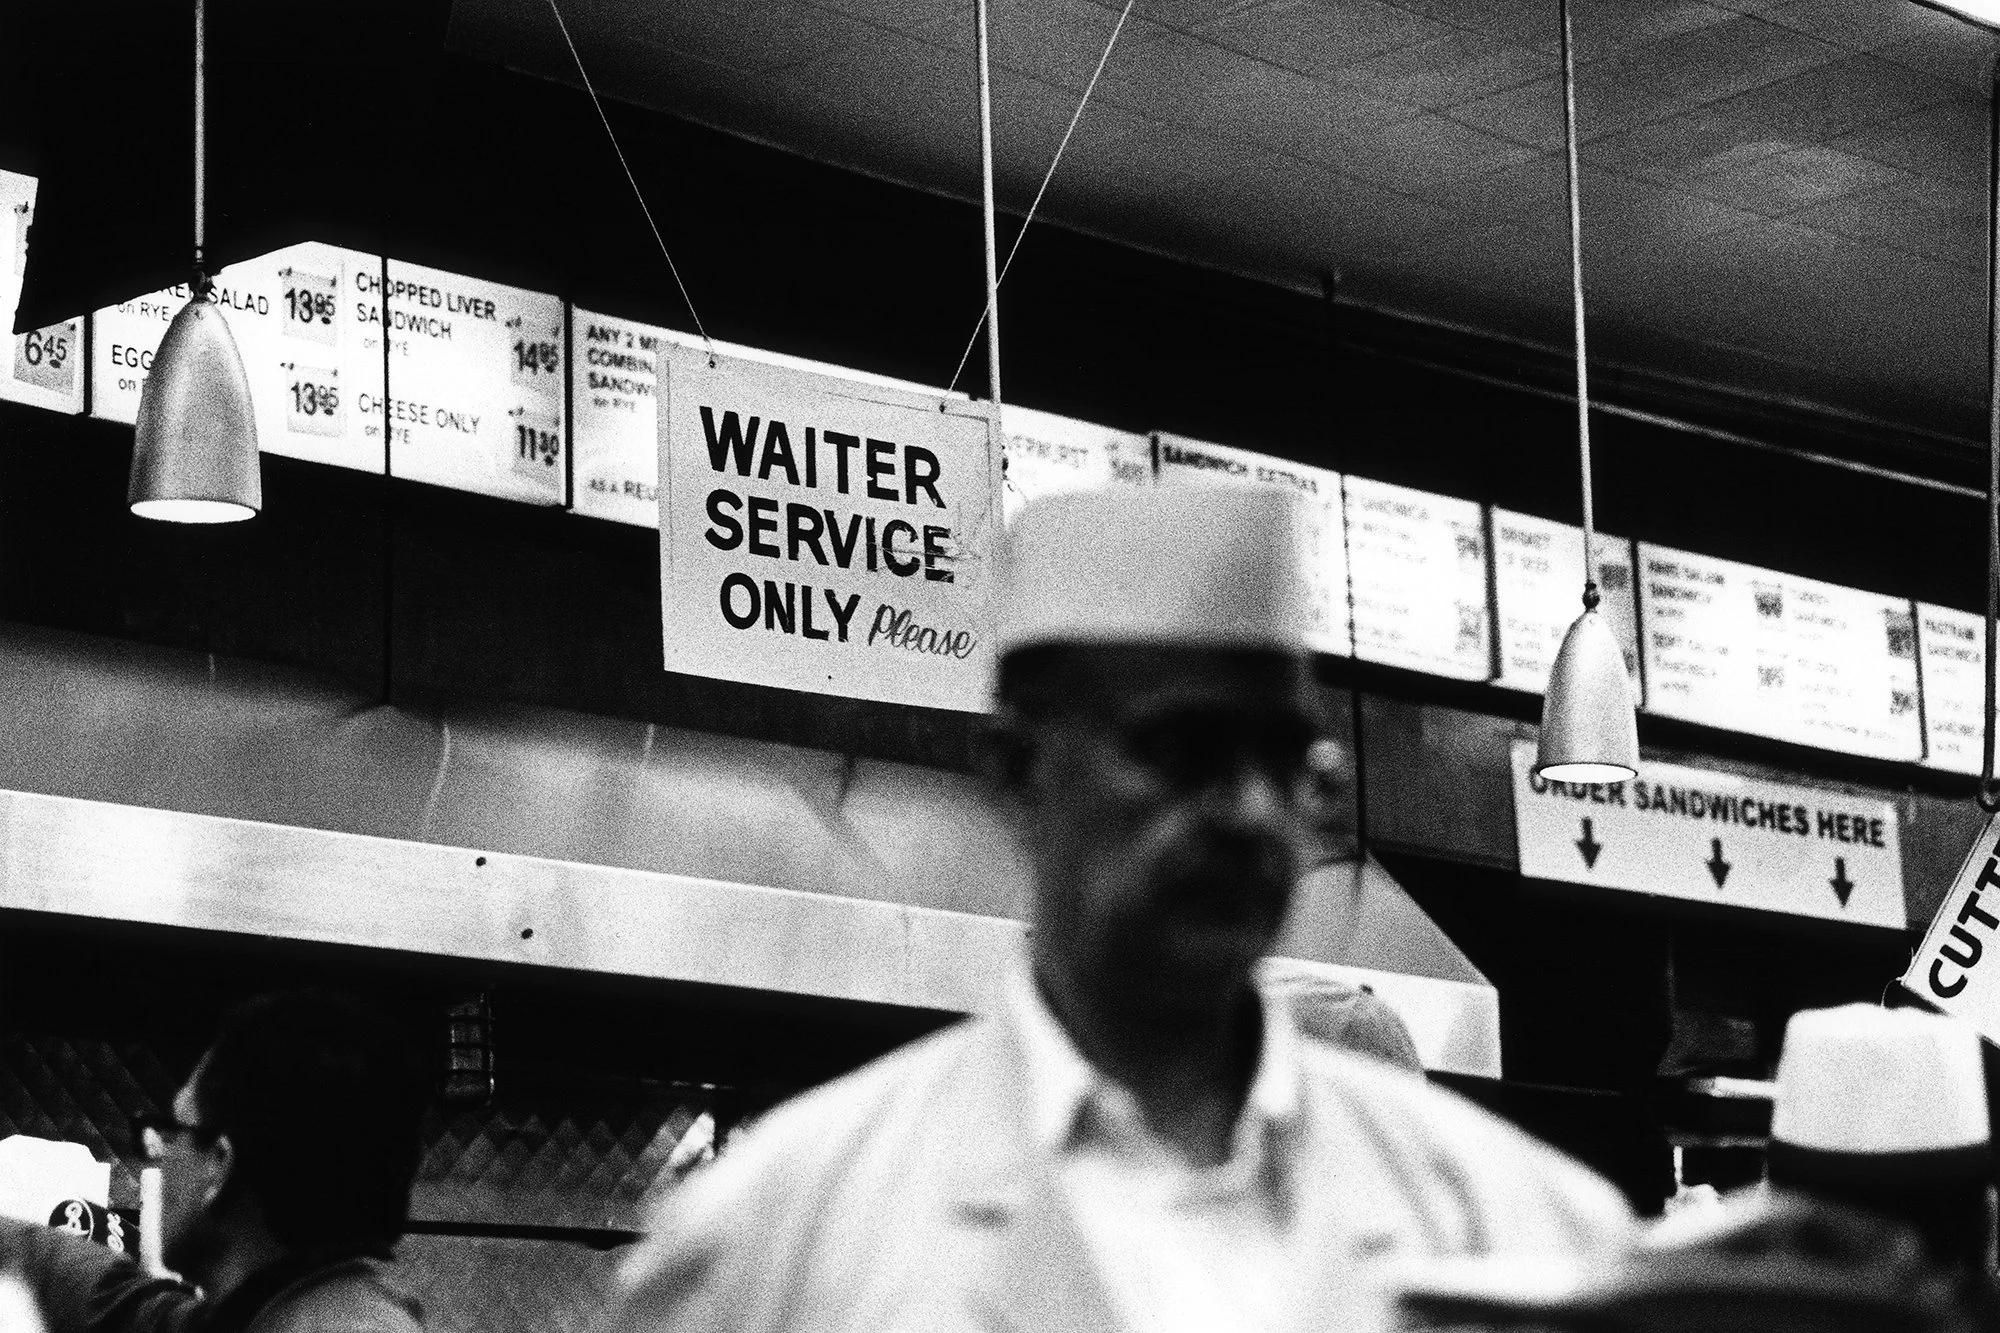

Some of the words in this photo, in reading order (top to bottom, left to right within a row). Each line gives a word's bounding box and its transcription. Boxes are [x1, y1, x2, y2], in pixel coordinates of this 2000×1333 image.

[140, 302, 170, 322] RYE
[206, 286, 269, 315] SALAD
[356, 272, 442, 308] CHOPPED
[447, 293, 497, 321] LIVER
[357, 302, 452, 340] SADWICH
[112, 344, 153, 370] EGG
[436, 408, 481, 434] ONLY
[699, 405, 947, 510] WAITER
[704, 488, 955, 584] SERVICE
[719, 572, 862, 643] ONLY
[867, 603, 978, 660] Please
[1633, 779, 1810, 836] SANDWICHES
[1817, 809, 1886, 849] HERE
[1928, 838, 2000, 999] CUTT
